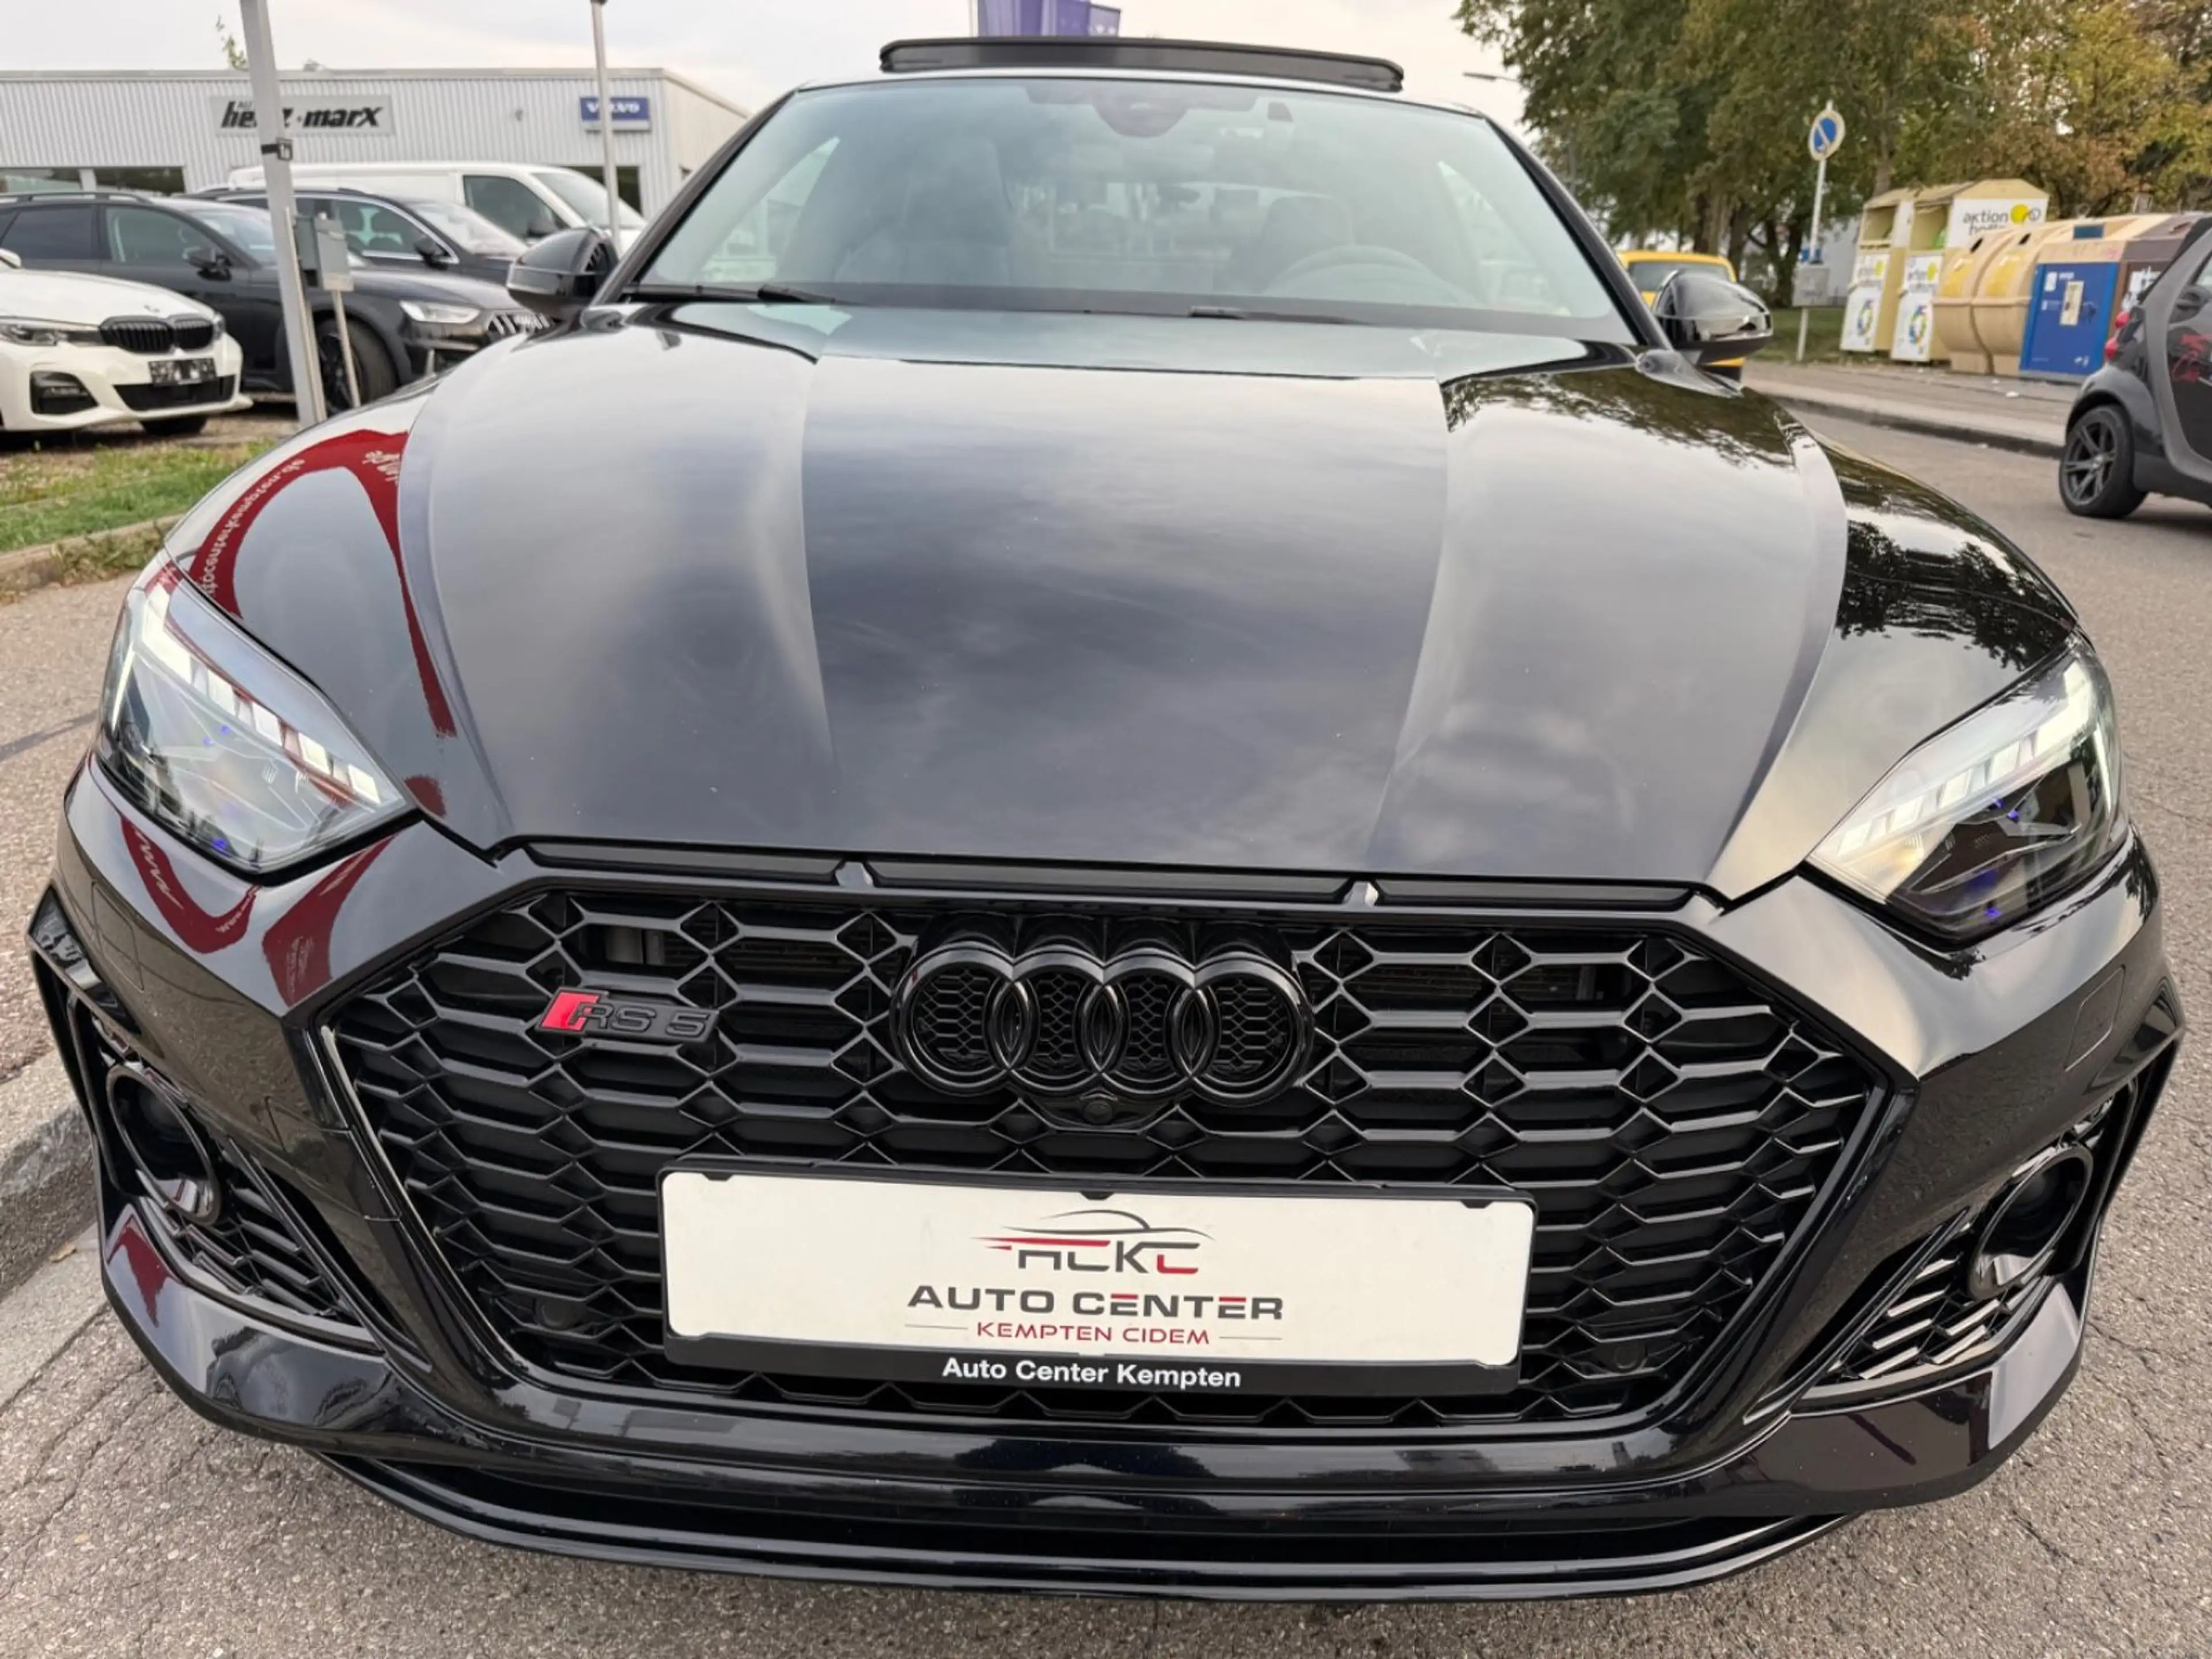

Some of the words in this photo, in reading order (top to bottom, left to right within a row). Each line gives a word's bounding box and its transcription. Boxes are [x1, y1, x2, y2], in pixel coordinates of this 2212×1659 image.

[907, 1285, 1055, 1314] AUTO
[1072, 1291, 1283, 1320] CENTER
[977, 1322, 1112, 1342] KEMPTEN
[1122, 1327, 1210, 1344] CIDEM
[942, 1357, 1007, 1378] Auto
[1015, 1360, 1109, 1382] Center
[1116, 1364, 1241, 1389] Kempten
